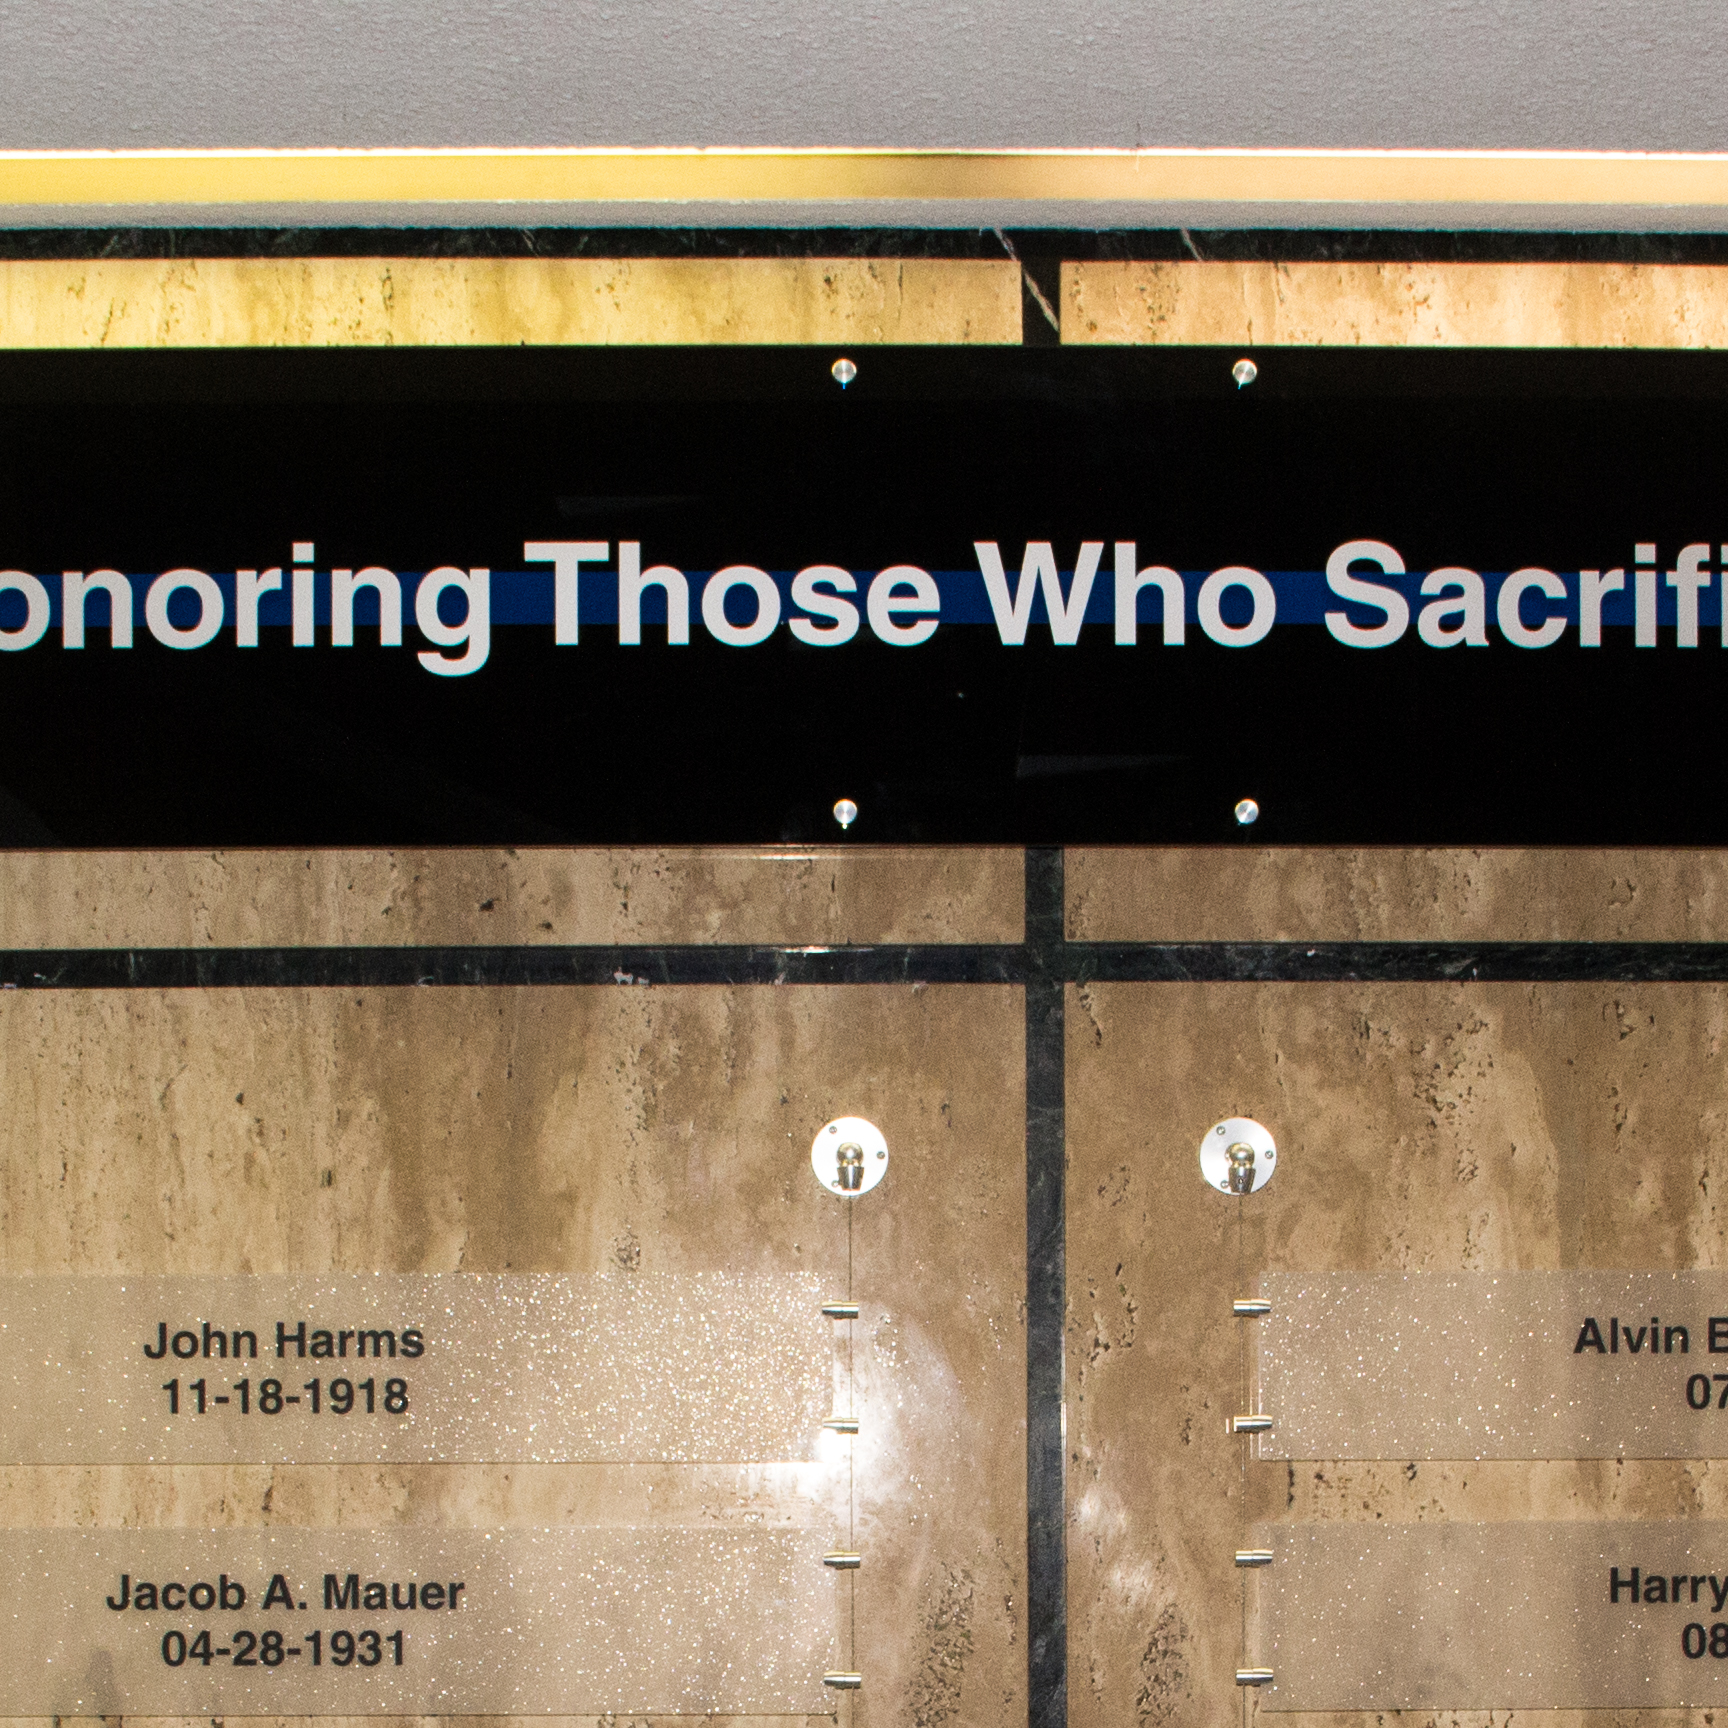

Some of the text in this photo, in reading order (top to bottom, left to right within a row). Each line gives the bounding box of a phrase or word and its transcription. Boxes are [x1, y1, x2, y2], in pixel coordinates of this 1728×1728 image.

[524, 542, 940, 645] Those
[974, 542, 1276, 646] Who
[144, 1322, 424, 1359] John Harms
[1575, 1318, 1689, 1354] Alvin
[164, 1378, 408, 1415] 11-18-1918
[107, 1574, 464, 1611] Jacob A. Mauer
[162, 1630, 402, 1667] 04-28-1931
